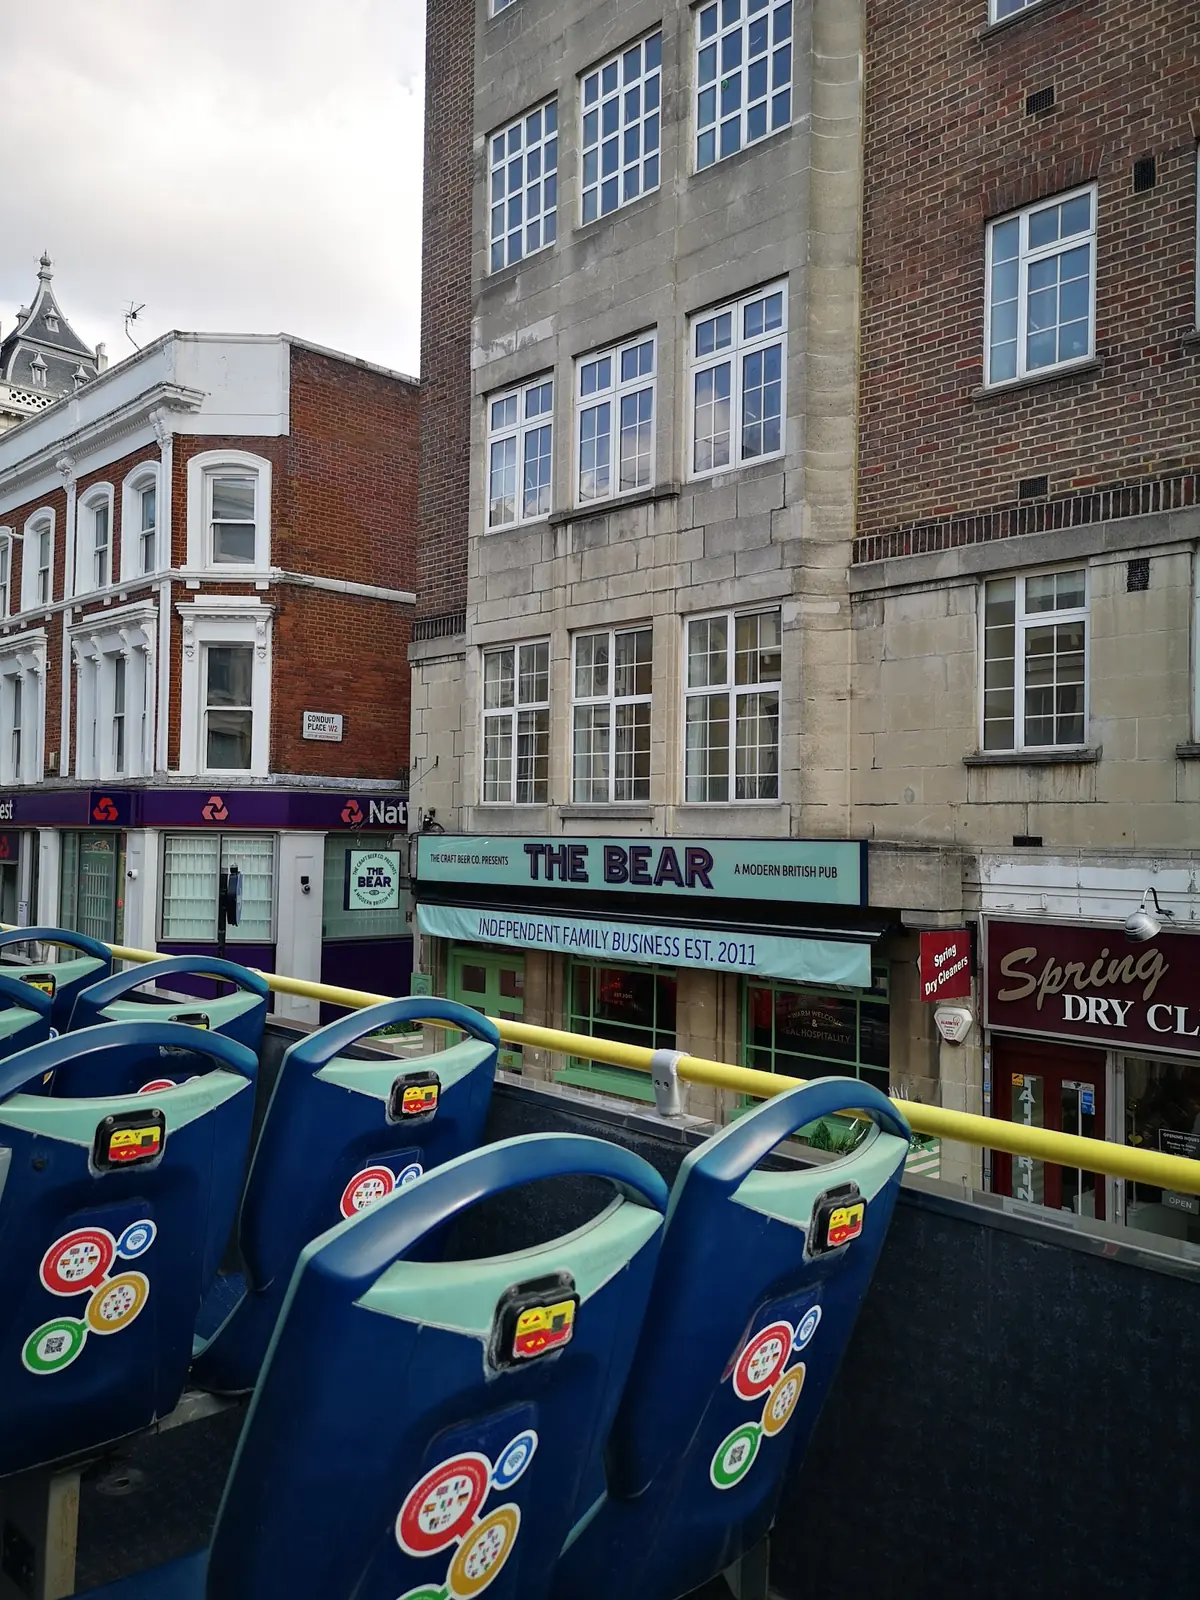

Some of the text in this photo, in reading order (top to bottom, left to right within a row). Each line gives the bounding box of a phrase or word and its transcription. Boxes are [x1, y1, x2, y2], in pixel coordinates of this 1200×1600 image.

[308, 715, 335, 724] CONDUIT
[308, 723, 326, 731] PLACE
[356, 856, 368, 867] CRAFT
[430, 854, 509, 865] THE CRAFT BEER CO. PRESENTS
[366, 867, 384, 875] THE
[523, 844, 714, 889] THE BEAR
[734, 864, 838, 878] A MODERN BRITISH PUB
[358, 876, 392, 887] BEAR
[478, 918, 756, 966] INDEPENDENT FAMILY BUSINESS EST. 2011
[934, 944, 957, 968] Spring
[925, 956, 969, 996] Dry Cleaners
[998, 947, 1169, 1011] Spring
[1062, 993, 1200, 1037] DRY CL
[811, 1019, 818, 1027] &
[801, 1029, 851, 1043] HOSPITALITY
[1169, 1196, 1192, 1209] OPEN
